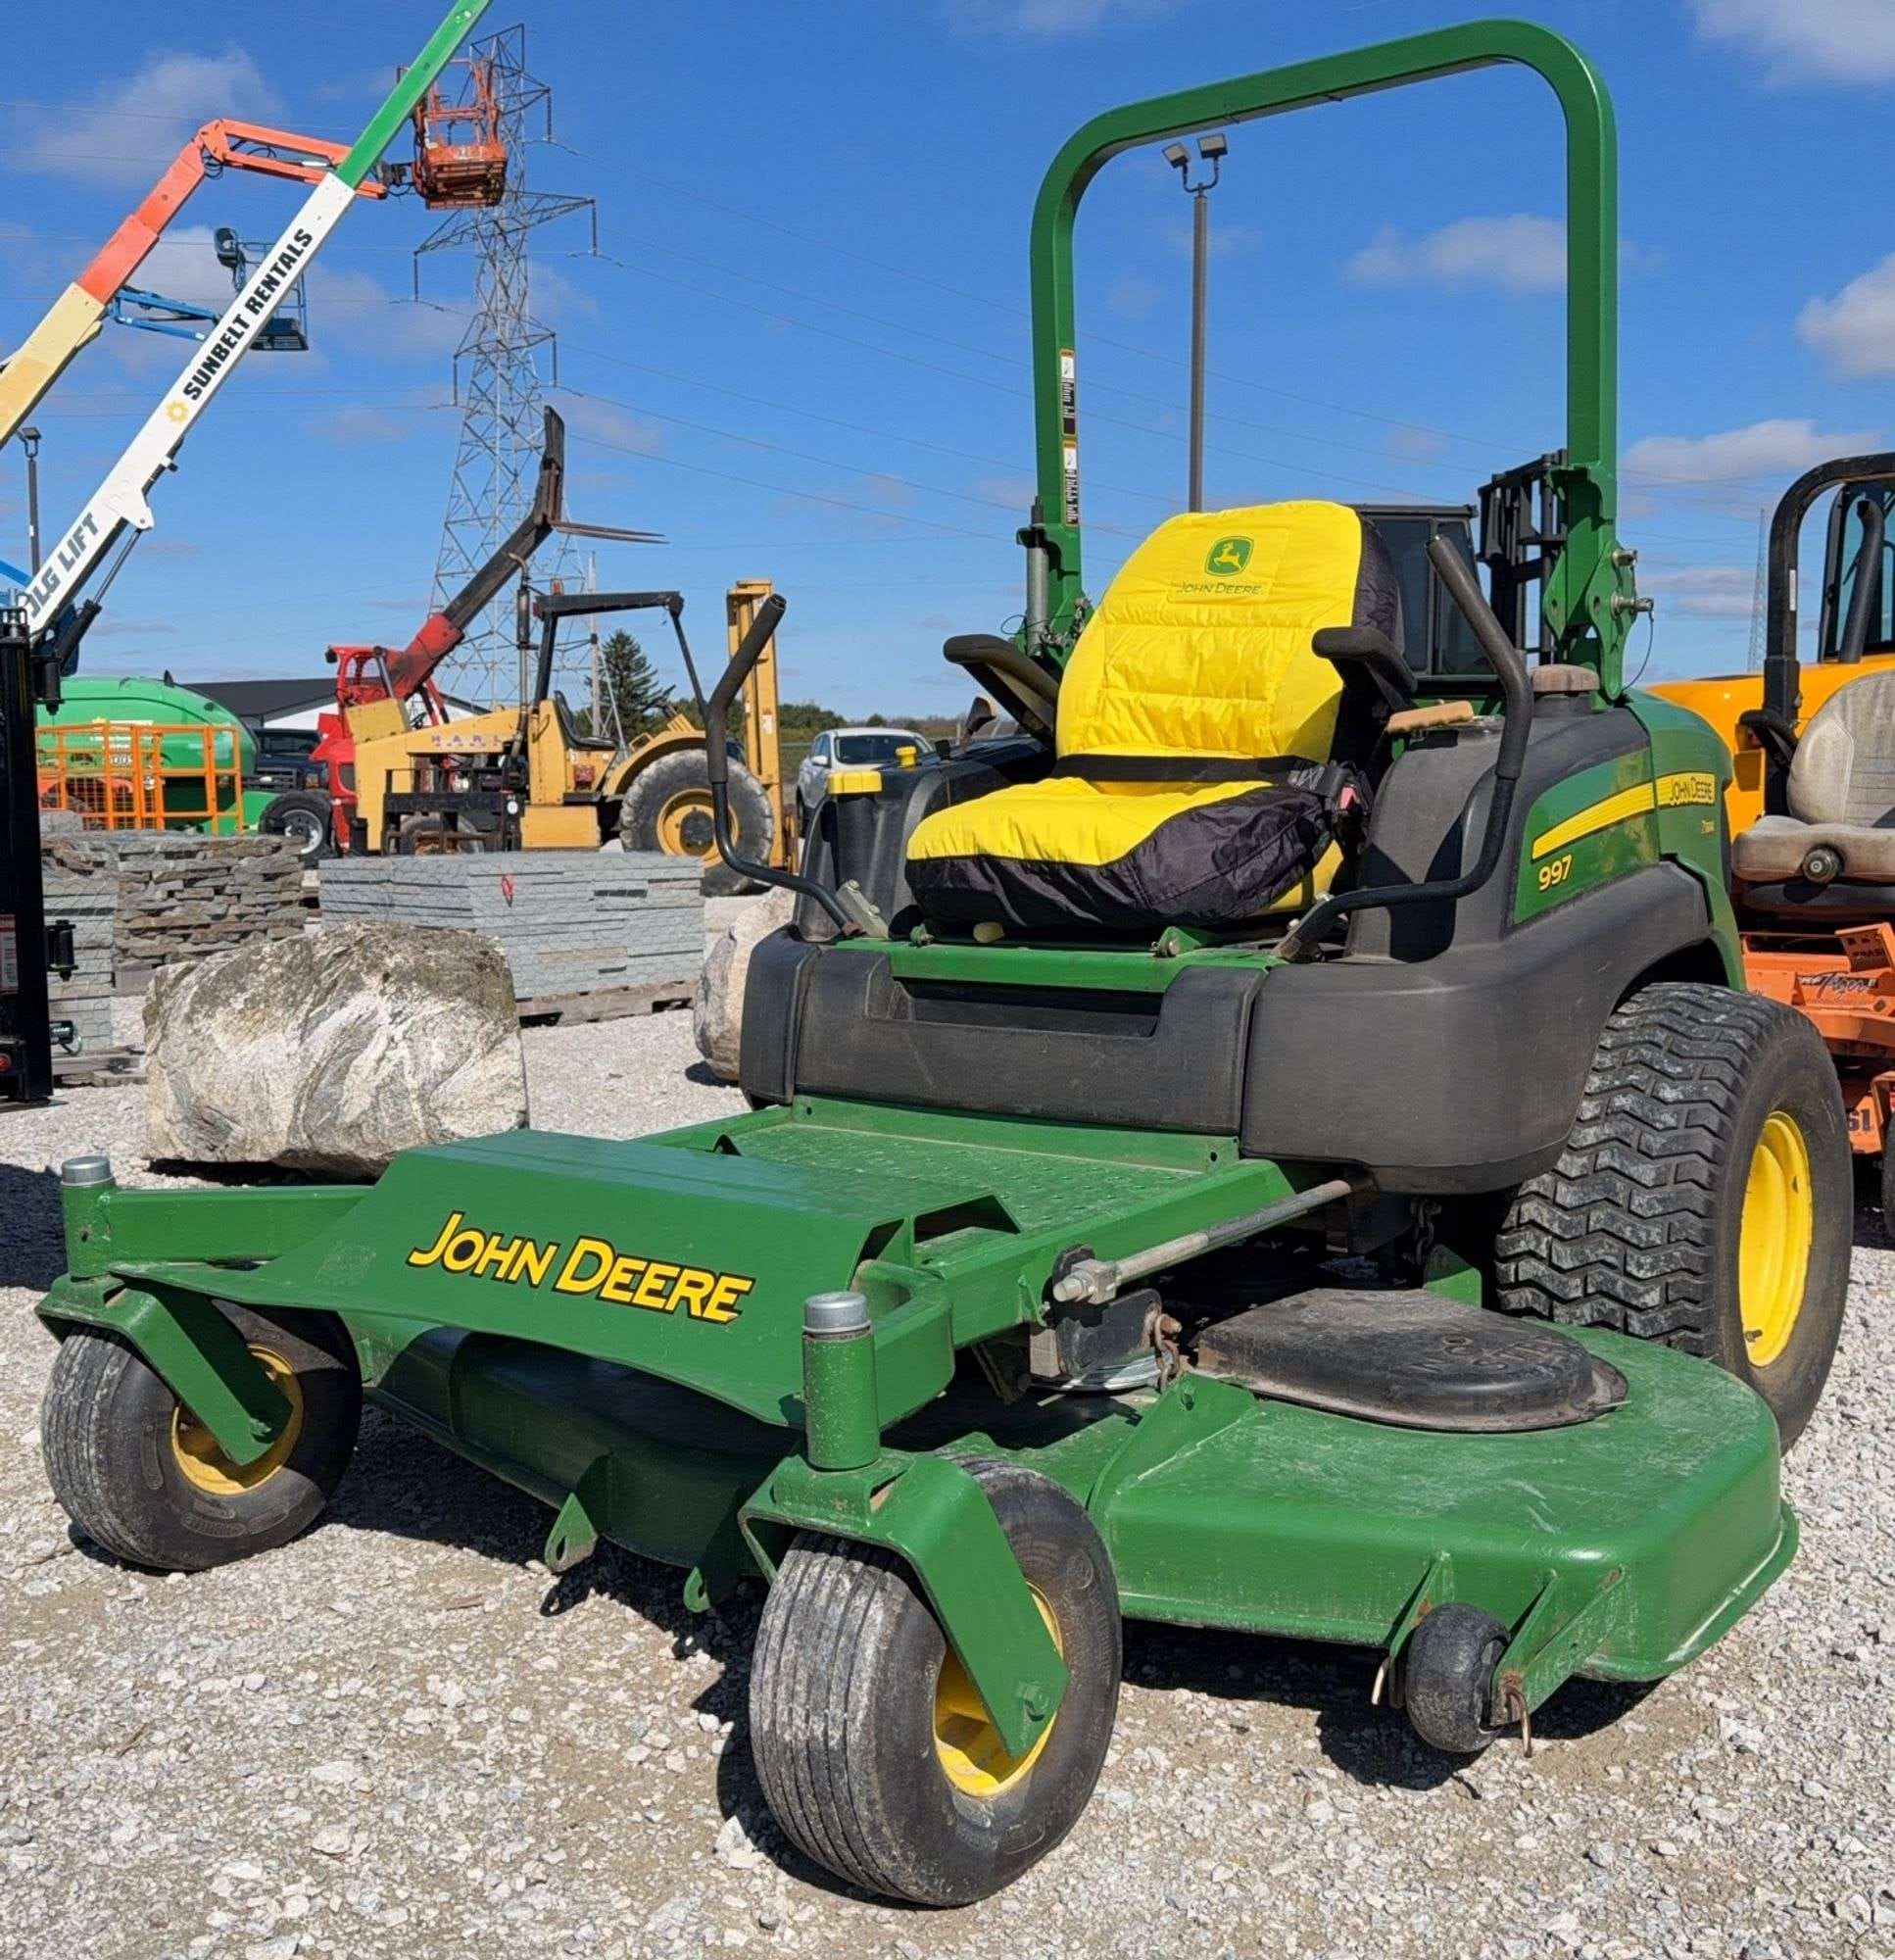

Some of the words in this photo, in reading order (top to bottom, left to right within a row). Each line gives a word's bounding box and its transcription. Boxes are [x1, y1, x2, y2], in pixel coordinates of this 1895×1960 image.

[182, 313, 251, 401] SUNBELT
[246, 227, 314, 324] RENTALS
[27, 566, 61, 619] JLG
[57, 513, 99, 572] LIFT
[1178, 581, 1212, 595] JOHN
[1213, 582, 1261, 595] DEERE
[1669, 778, 1690, 801] JOHN
[1688, 776, 1713, 800] DEERE
[1537, 855, 1572, 891] 997
[407, 1210, 559, 1287] JOHN
[554, 1236, 756, 1324] DEERE
